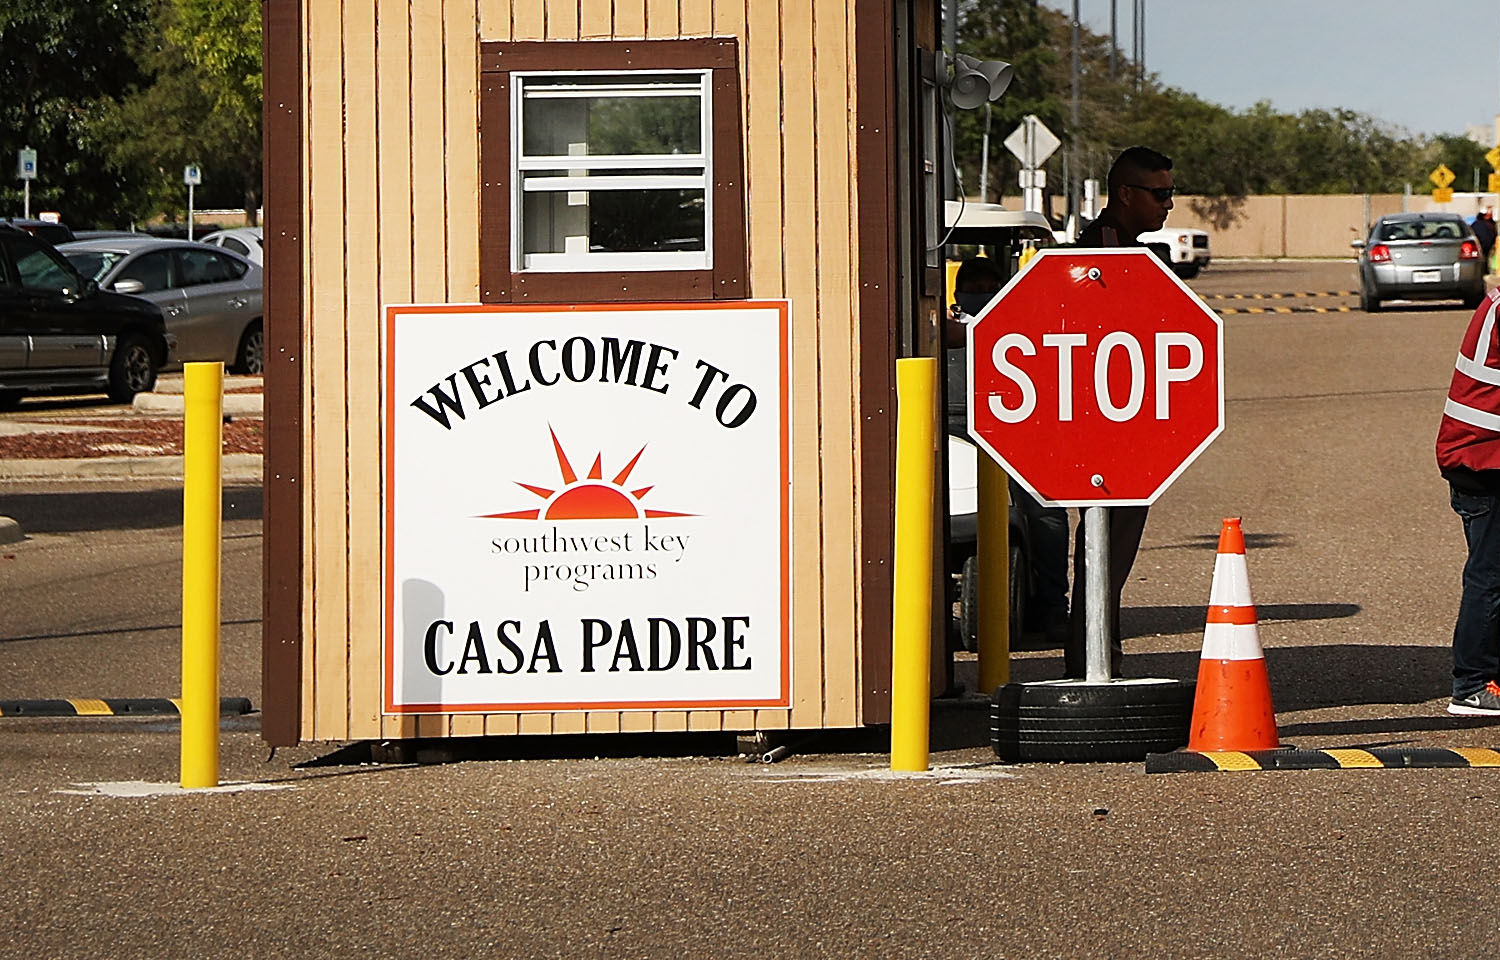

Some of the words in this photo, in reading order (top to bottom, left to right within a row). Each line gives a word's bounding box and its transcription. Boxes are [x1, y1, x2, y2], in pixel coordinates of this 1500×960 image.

[410, 336, 679, 431] WELCOME
[687, 359, 758, 429] TO
[988, 331, 1204, 424] STOP
[491, 527, 634, 555] southwest
[644, 526, 690, 563] key
[523, 559, 658, 593] programs
[424, 619, 563, 676] CASA
[580, 617, 752, 673] PADRE
